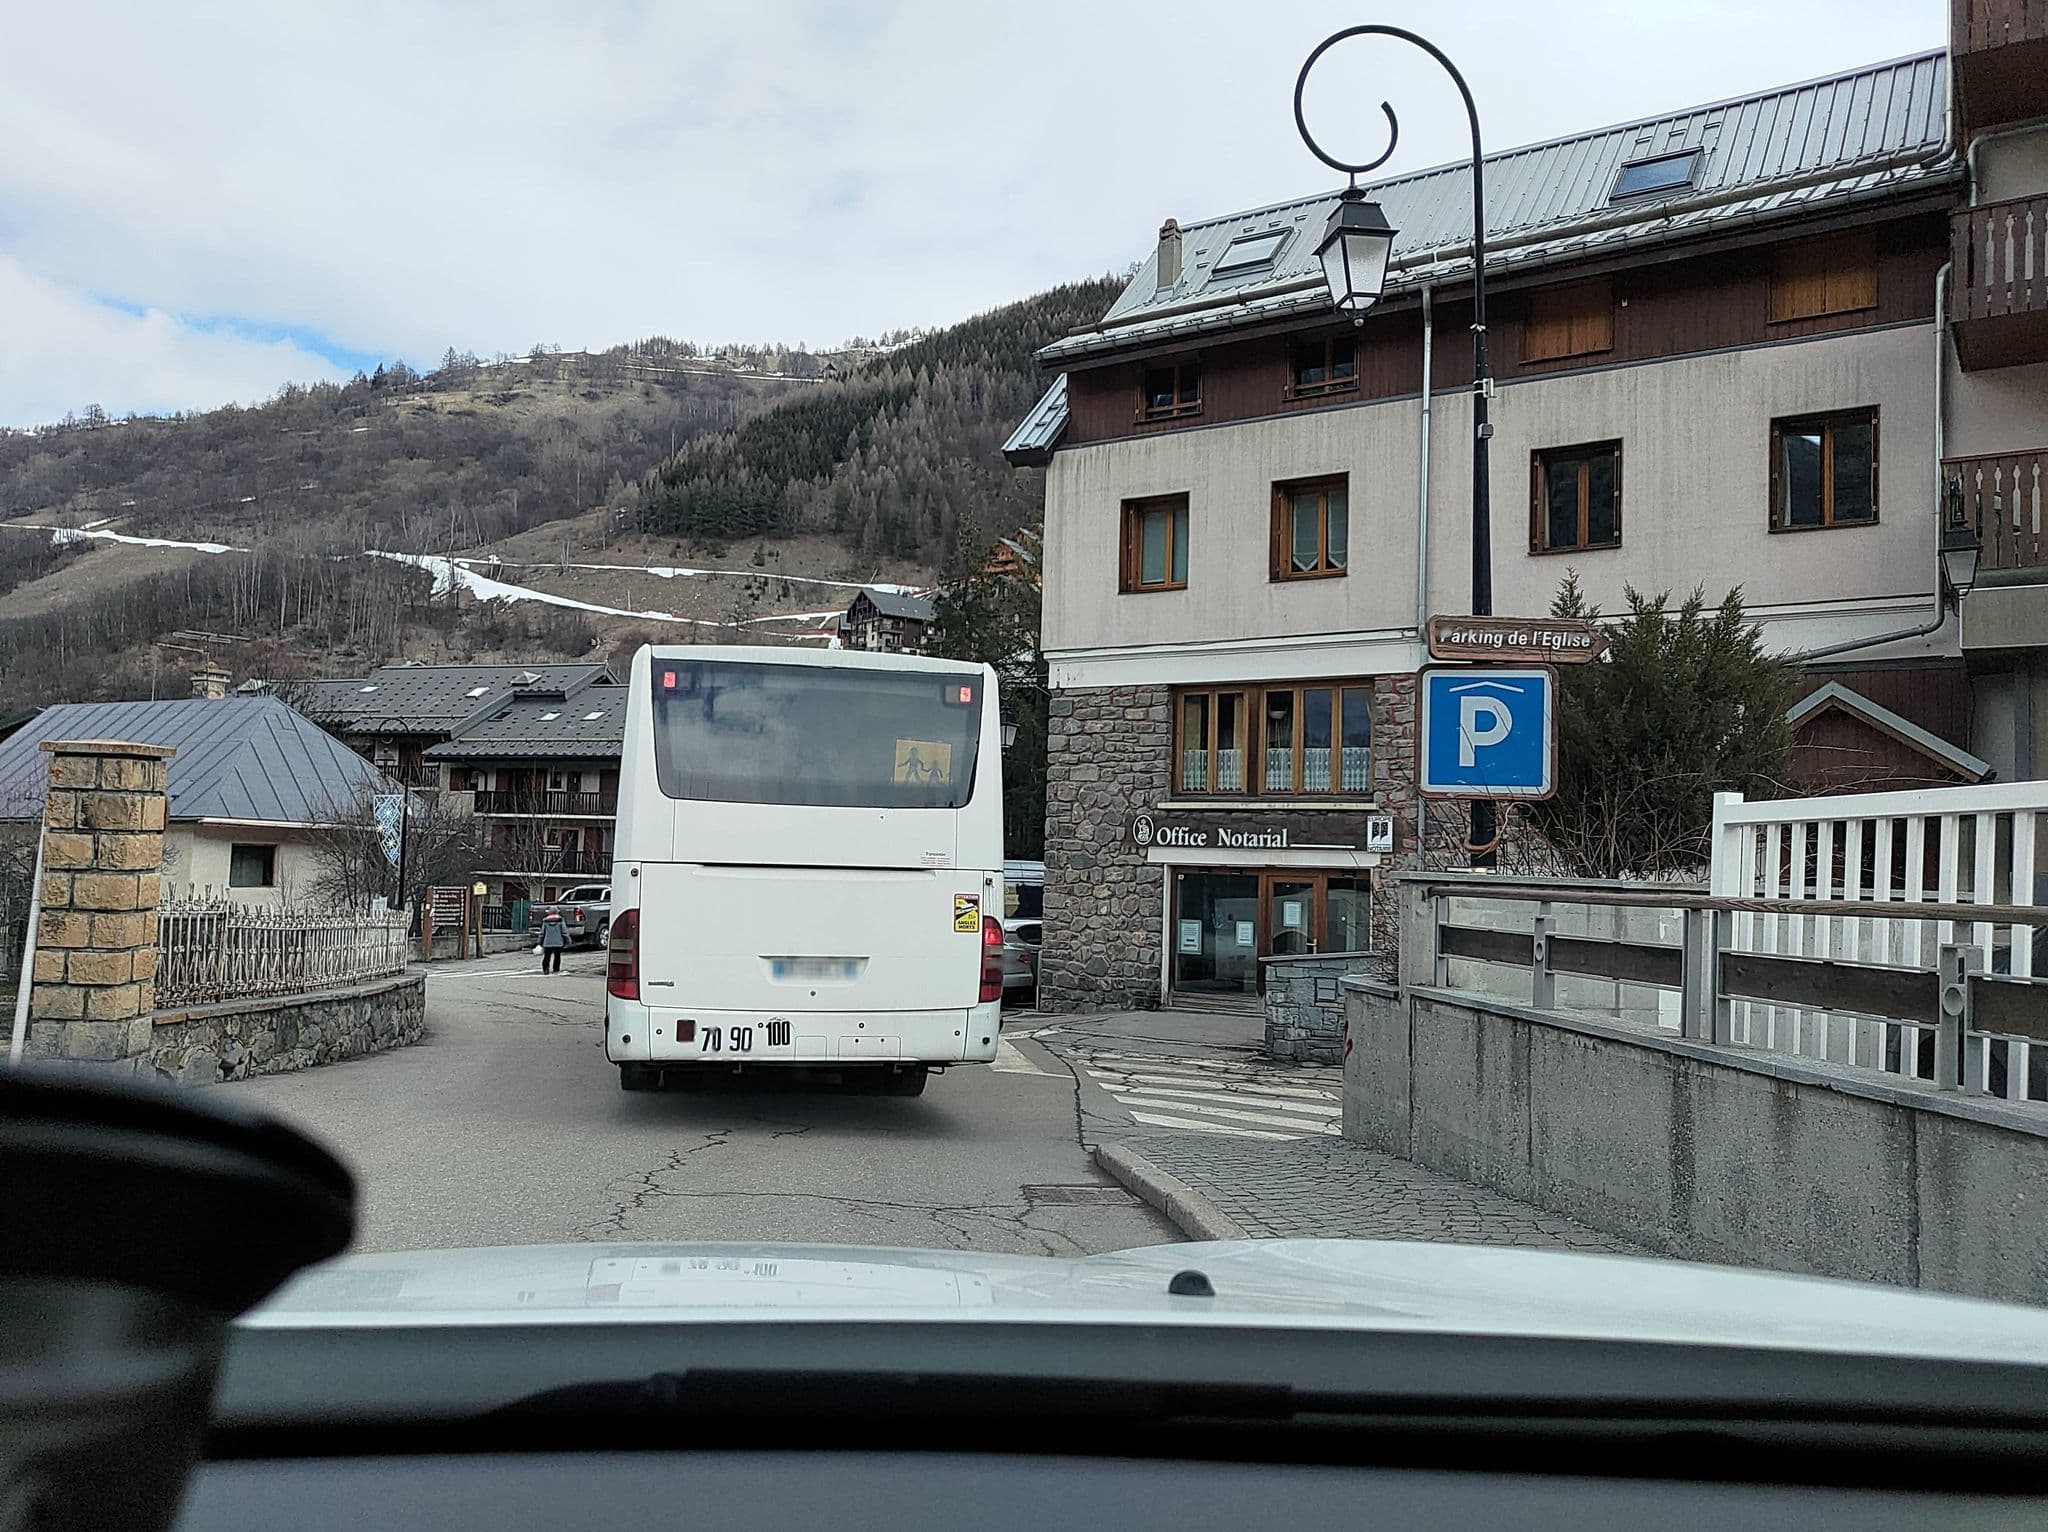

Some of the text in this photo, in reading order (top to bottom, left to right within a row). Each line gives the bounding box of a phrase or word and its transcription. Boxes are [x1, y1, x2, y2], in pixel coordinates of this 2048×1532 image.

[1508, 631, 1528, 646] de
[1458, 695, 1513, 767] P
[1156, 827, 1288, 848] Office Notarial
[701, 1020, 791, 1052] 70 90 100
